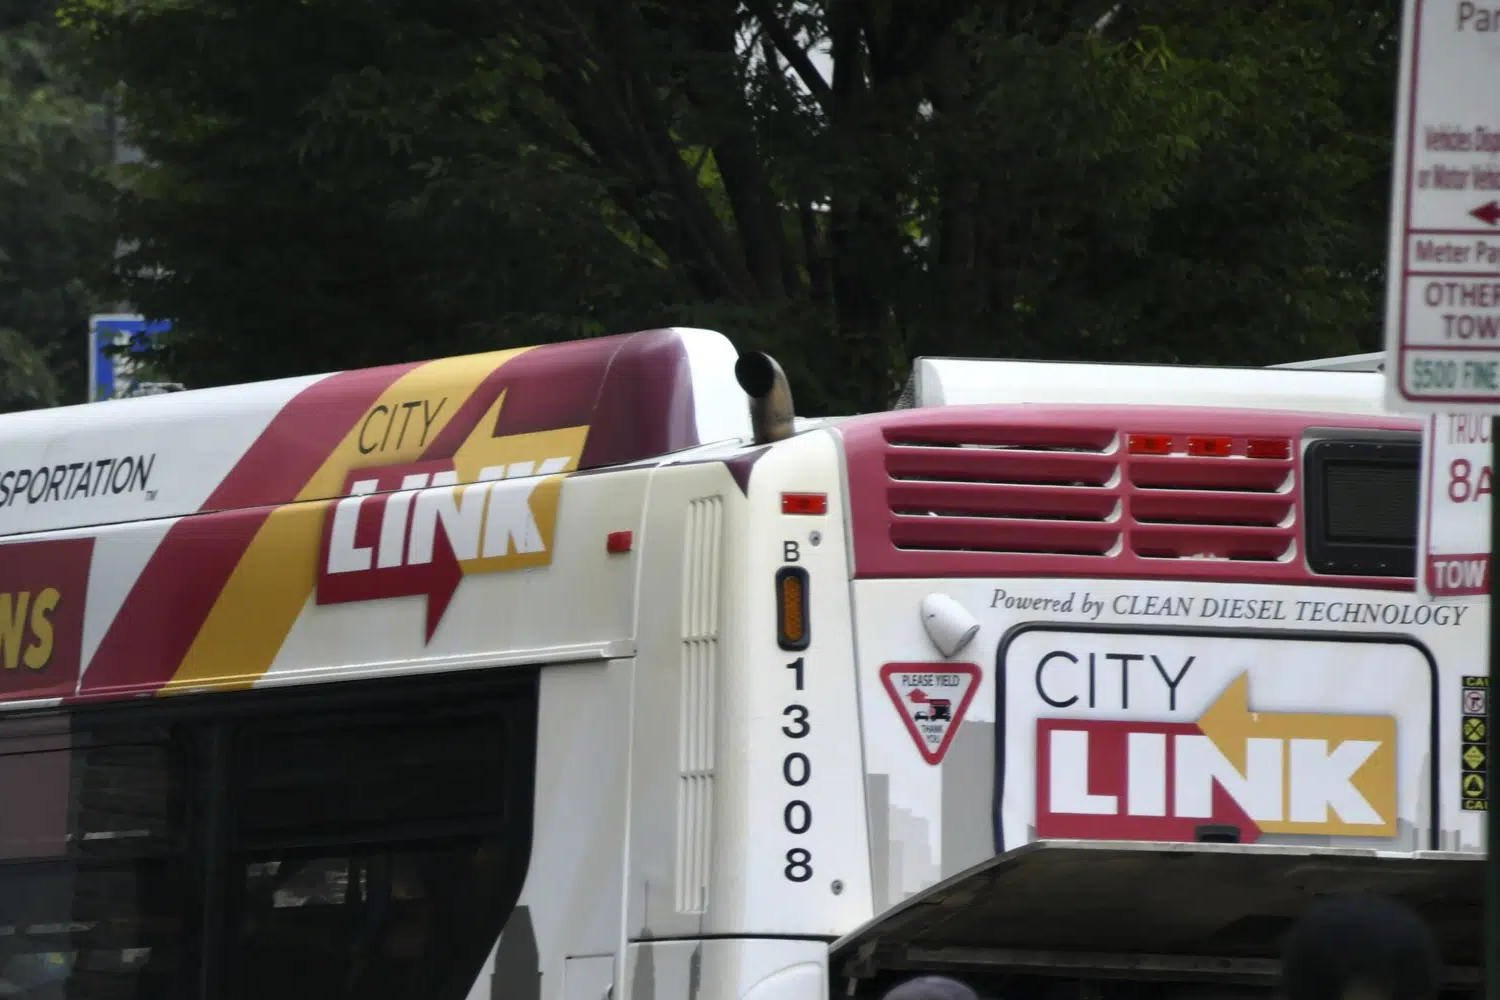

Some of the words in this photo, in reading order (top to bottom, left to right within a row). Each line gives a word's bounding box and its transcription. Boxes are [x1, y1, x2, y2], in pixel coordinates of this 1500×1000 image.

[1416, 239, 1471, 264] Meter
[1476, 240, 1500, 268] Pa
[358, 397, 448, 456] CITY
[327, 456, 572, 575] LINK
[783, 540, 801, 562] B
[1431, 560, 1487, 590] TOW
[990, 588, 1074, 613] Powered
[1081, 597, 1105, 620] by
[1112, 595, 1195, 618] CLEAN
[1200, 599, 1288, 621] DIESEL
[1295, 601, 1470, 626] TECHNOLOGY
[902, 674, 933, 687] PLEASE
[935, 675, 961, 687] YIELD
[1035, 650, 1197, 711] CITY
[1465, 677, 1489, 687] CA
[922, 724, 943, 734] THANK
[926, 735, 940, 744] YOU
[1049, 729, 1387, 826] LINK
[1465, 800, 1489, 810] CA
